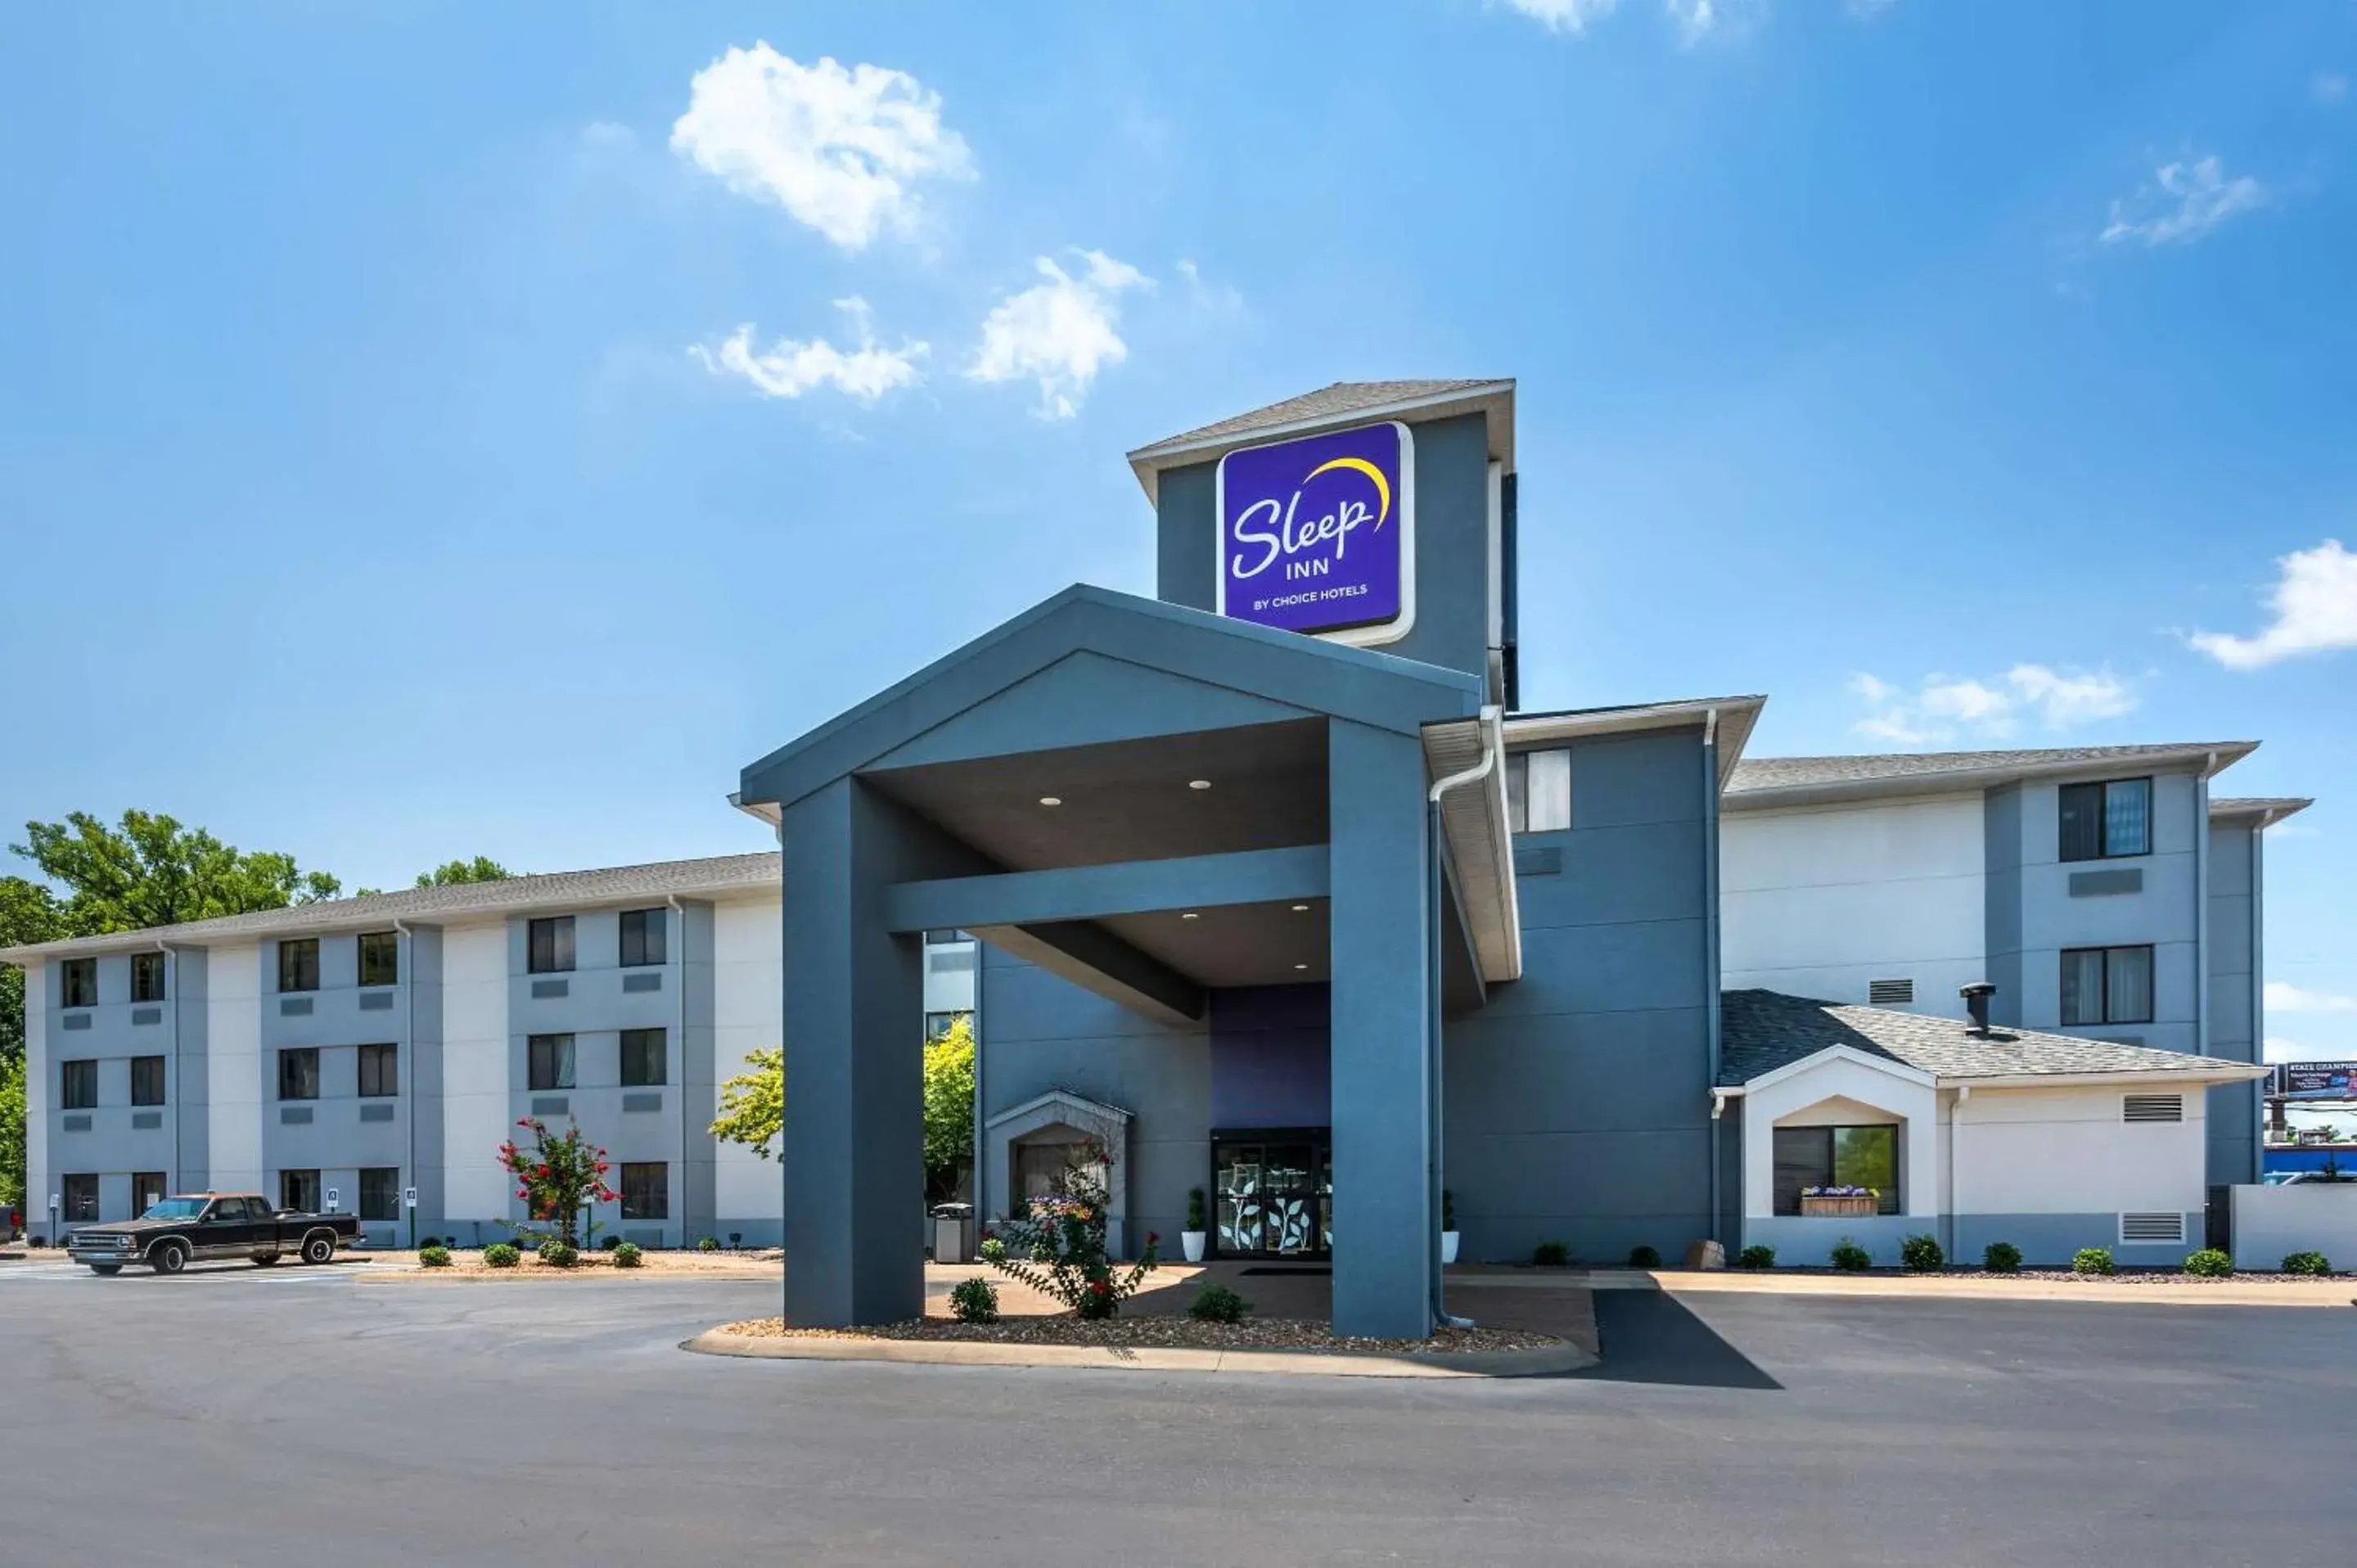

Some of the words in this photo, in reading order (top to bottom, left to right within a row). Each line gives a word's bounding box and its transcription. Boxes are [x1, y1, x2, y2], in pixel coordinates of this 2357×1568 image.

[1232, 490, 1374, 579] Sleep
[1286, 557, 1329, 580] INN
[1254, 600, 1269, 611] BY
[1272, 591, 1318, 608] CHOICE
[1320, 583, 1368, 600] HOTELS
